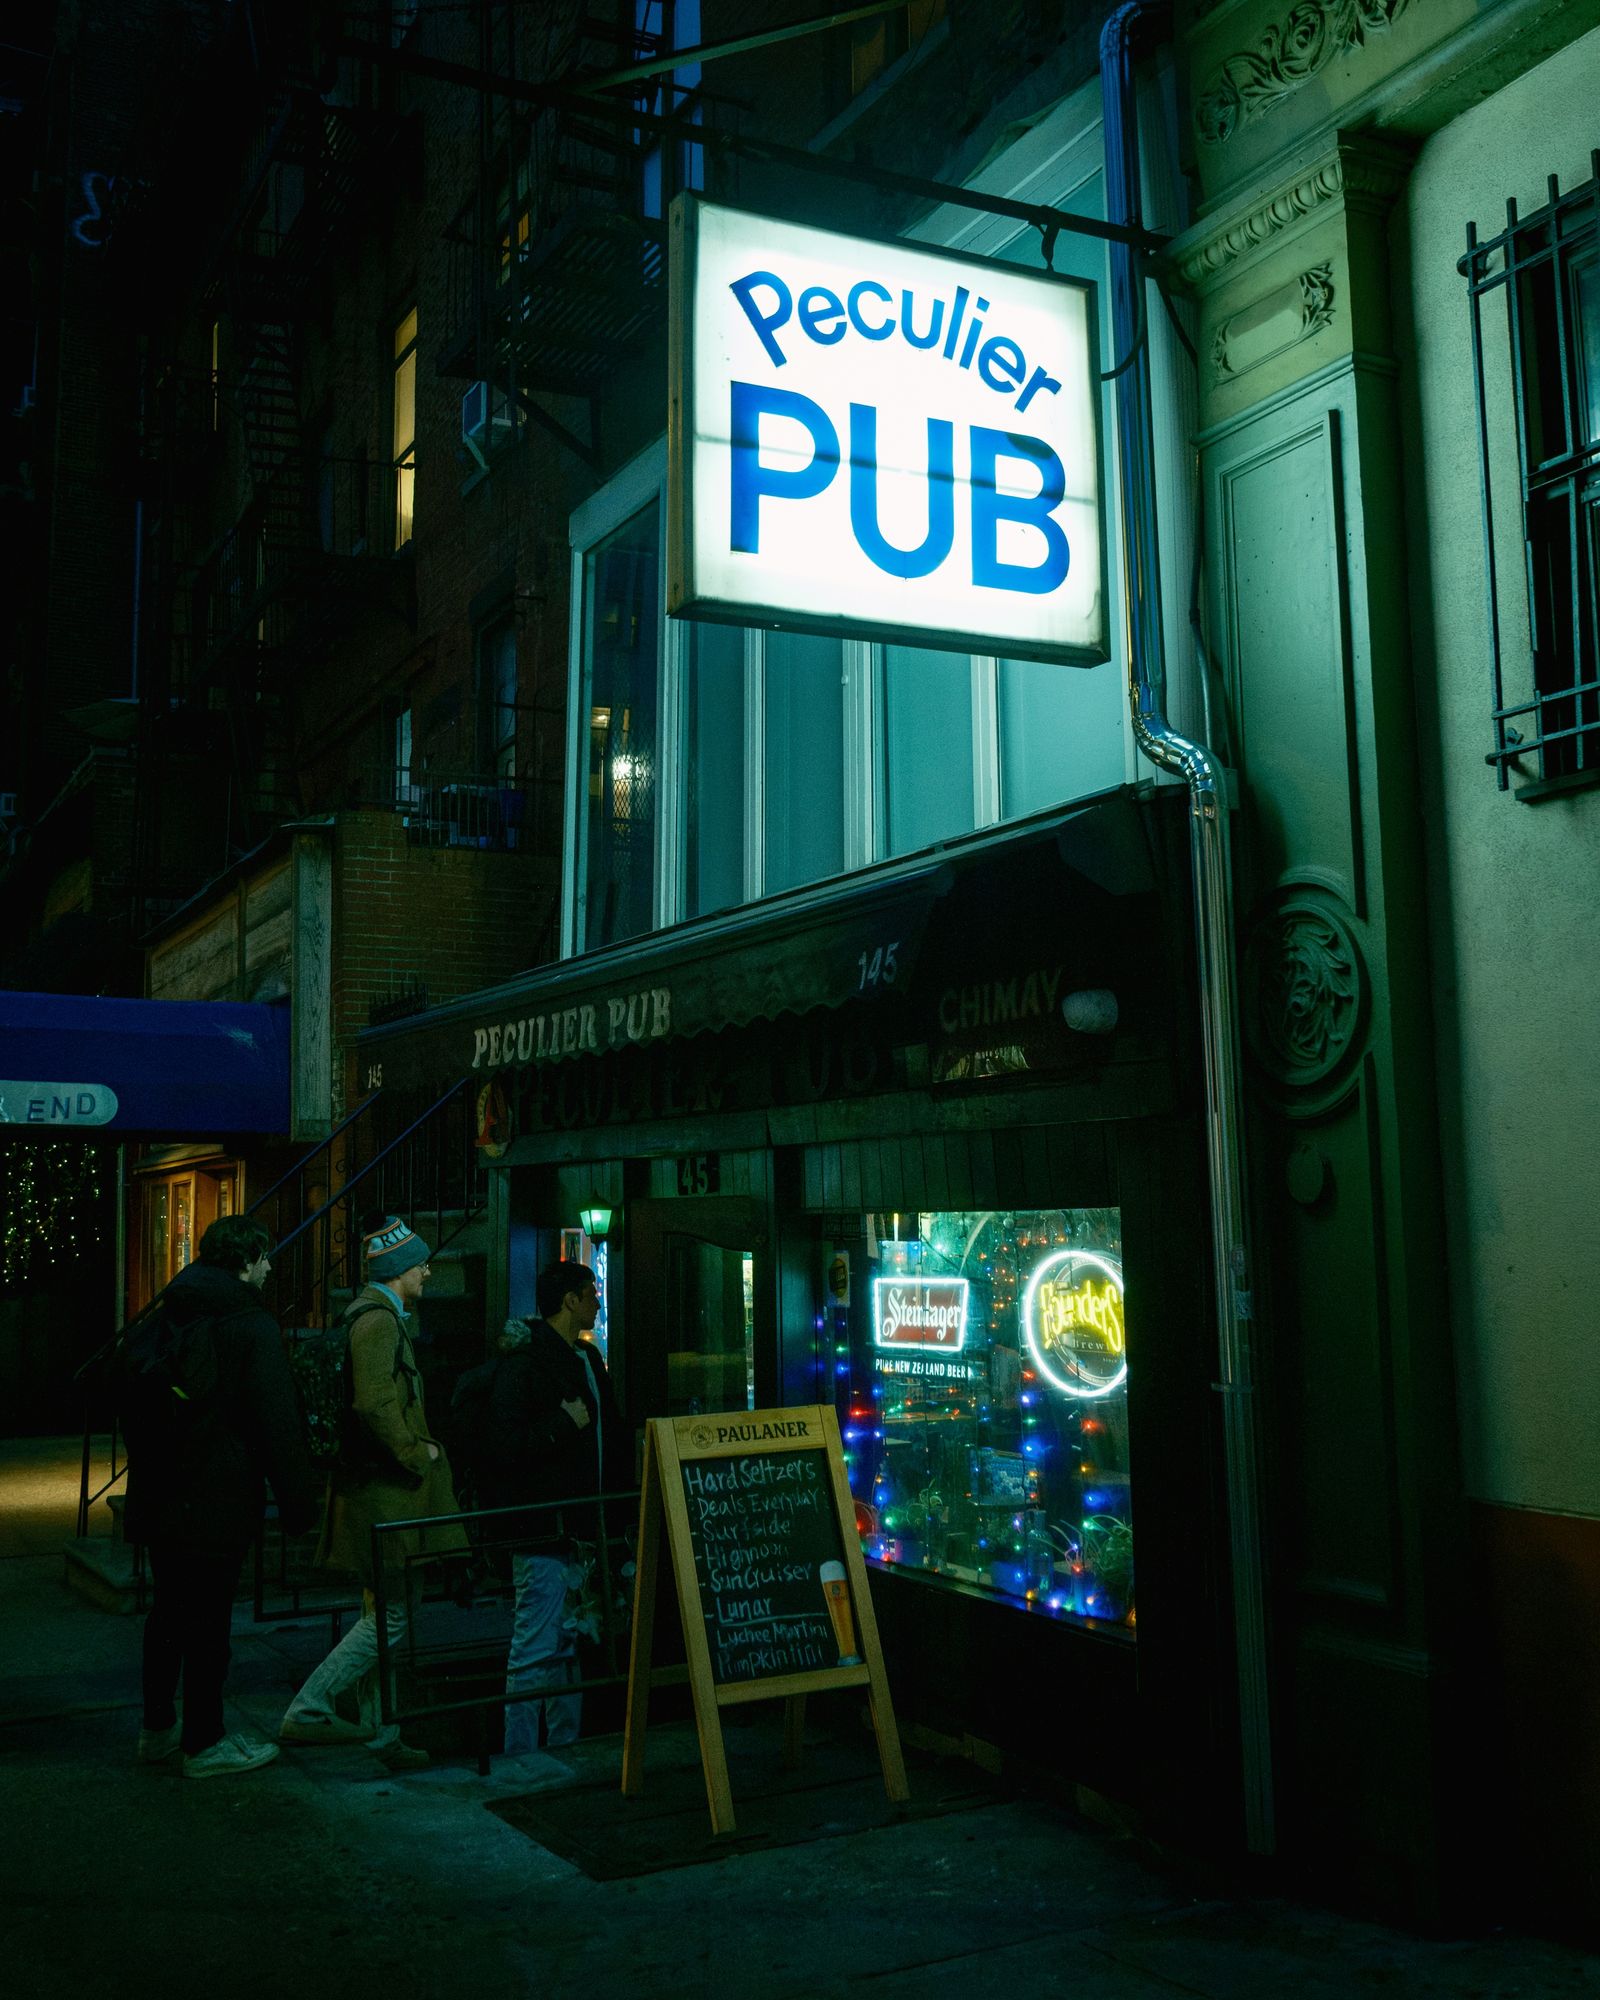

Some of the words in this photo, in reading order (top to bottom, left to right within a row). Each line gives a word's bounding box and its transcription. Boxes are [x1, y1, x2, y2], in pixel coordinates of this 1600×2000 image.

[729, 270, 1062, 414] Peculier
[730, 380, 1070, 595] PUB
[858, 941, 899, 992] 145
[938, 964, 1067, 1034] CHIMAY
[471, 1003, 598, 1069] PECULIER
[607, 986, 672, 1041] PUB
[368, 1063, 382, 1089] 145
[27, 1092, 96, 1122] END
[883, 1287, 961, 1342] Steinlager
[876, 1358, 894, 1372] PURE
[895, 1360, 911, 1374] NEW
[947, 1364, 966, 1378] BEER
[716, 1421, 810, 1444] PAULANER
[684, 1461, 740, 1496] Hard
[697, 1493, 747, 1521] Deals
[716, 1597, 772, 1625] Lunar
[716, 1626, 772, 1649] Lychee
